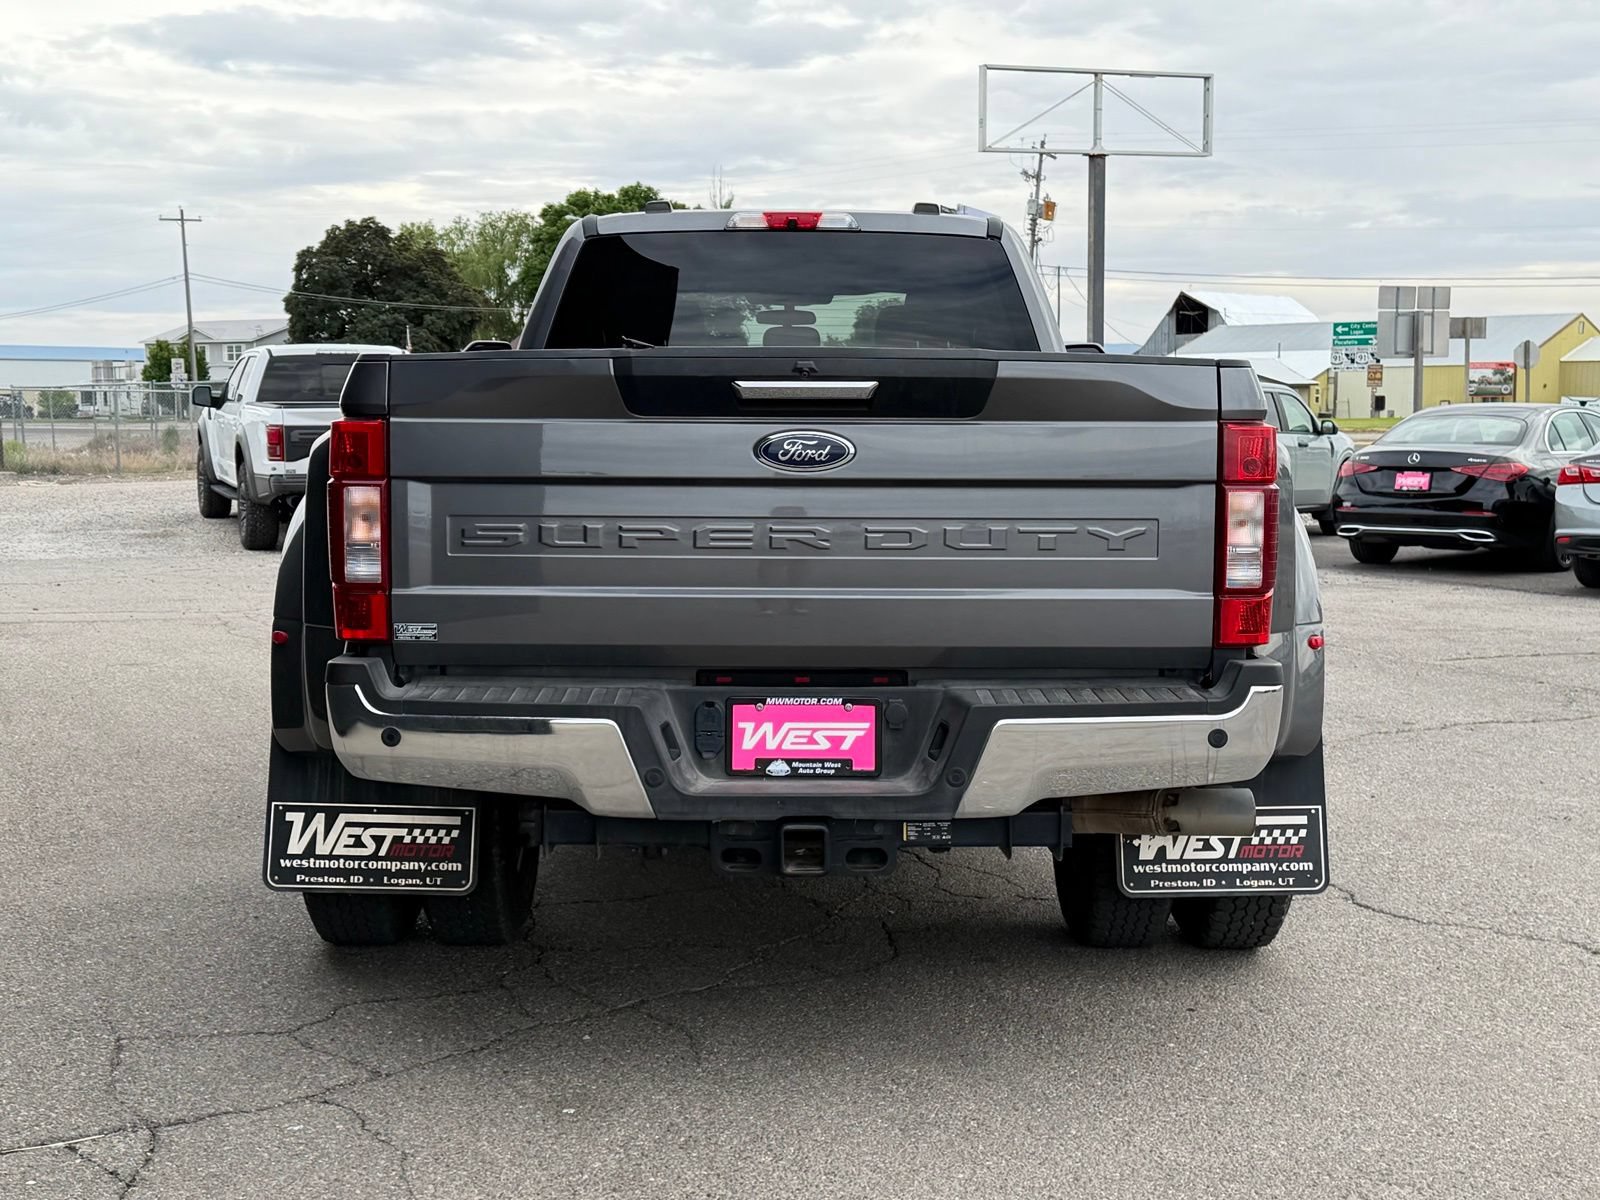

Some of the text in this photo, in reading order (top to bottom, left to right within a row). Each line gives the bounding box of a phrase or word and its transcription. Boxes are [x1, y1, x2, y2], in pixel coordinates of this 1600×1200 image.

[1332, 354, 1341, 362] 91
[1358, 354, 1367, 362] 91
[778, 439, 831, 461] Ford
[460, 522, 1147, 551] SUPER DUTY
[765, 697, 843, 706] MWMOTOR.COM
[737, 721, 871, 751] WEST
[791, 761, 842, 769] Mountain West
[815, 767, 836, 776] Group
[285, 811, 461, 857] WEST
[389, 843, 456, 858] MOTOR
[1239, 844, 1305, 859] MOTOR
[279, 857, 463, 873] westmotorcompany.com
[1133, 861, 1314, 875] westmotorcompany.com
[296, 874, 443, 886] Preston, ID Logan, UT
[1150, 877, 1296, 888] Preston, ID Logan, UT
